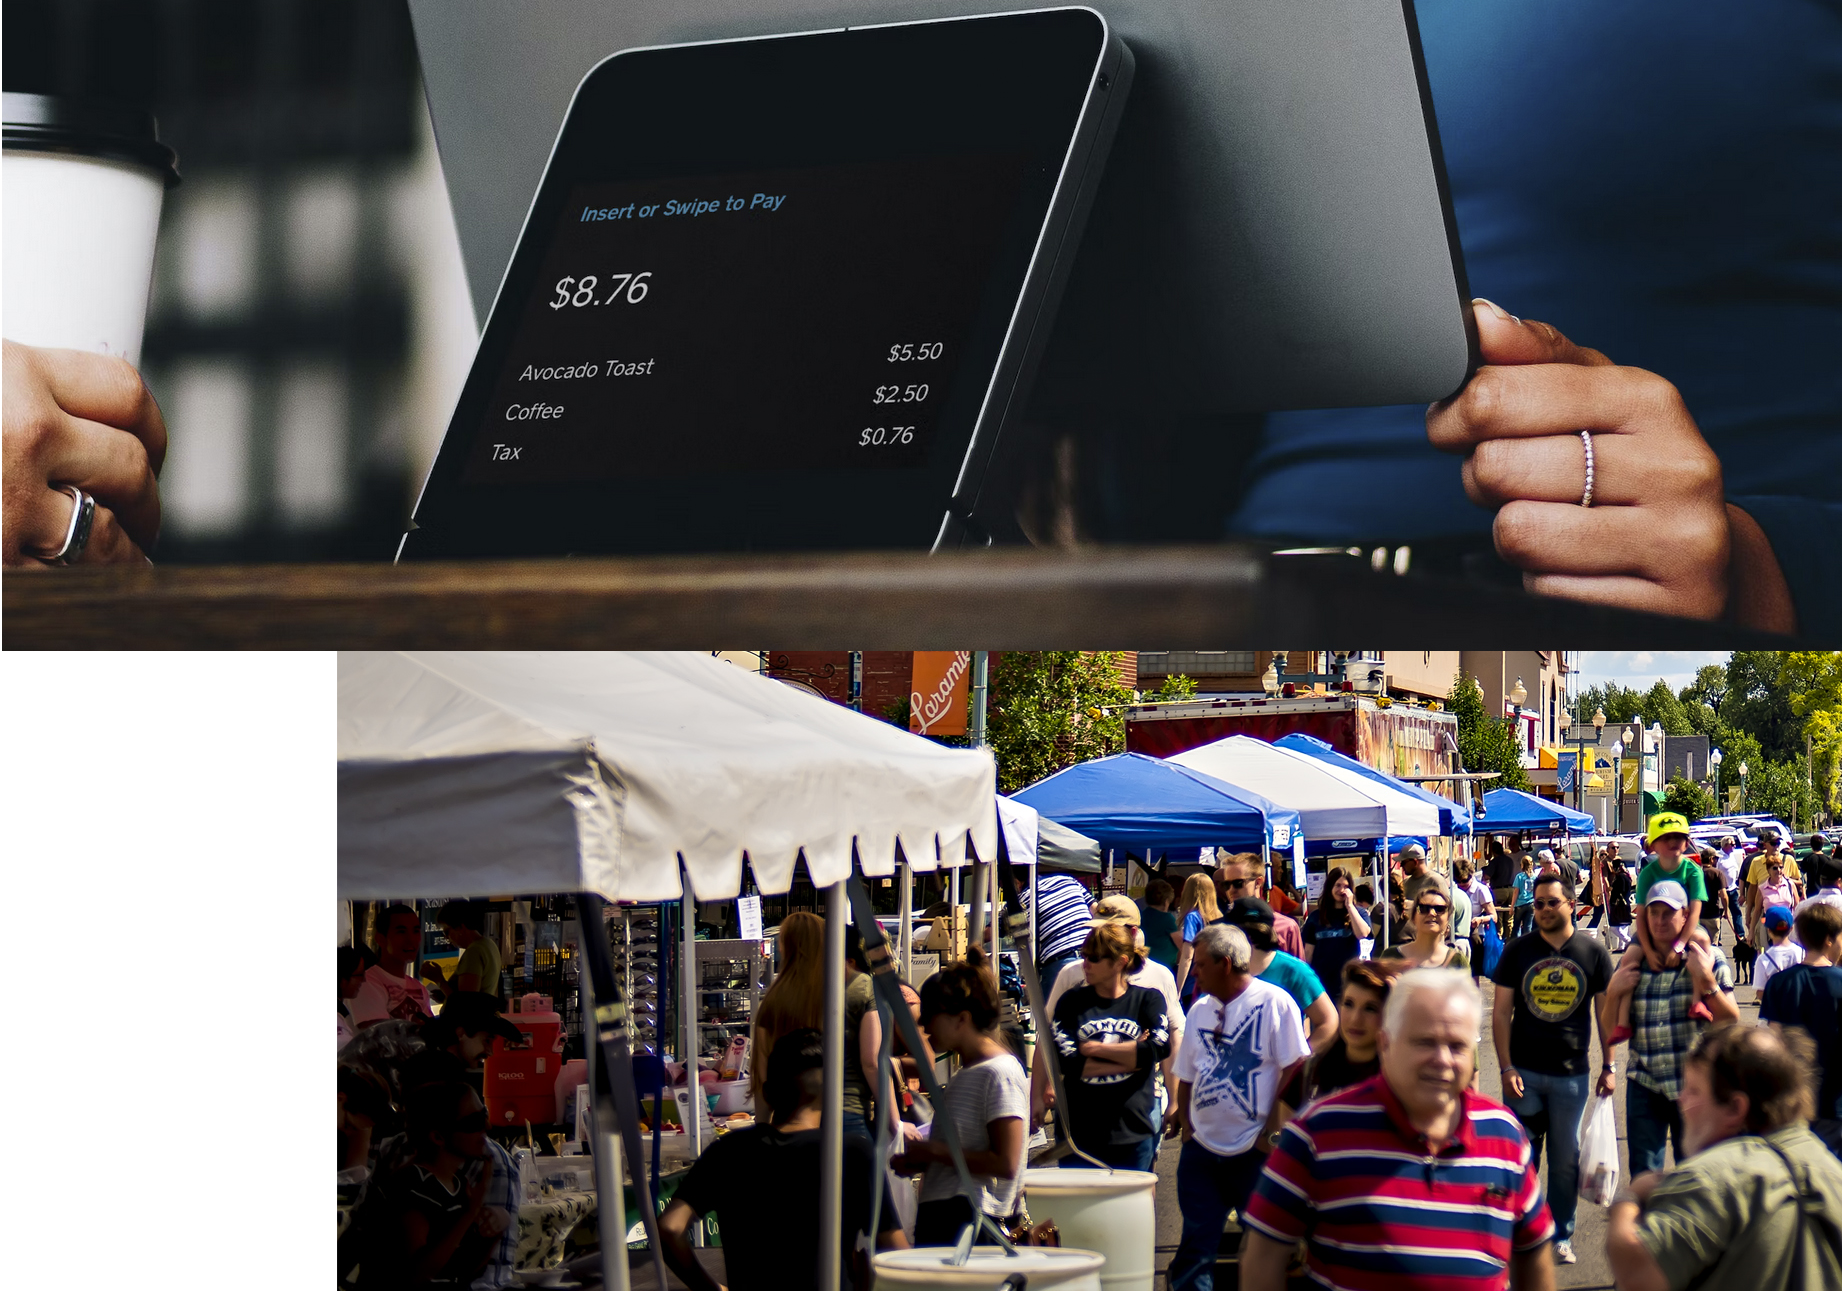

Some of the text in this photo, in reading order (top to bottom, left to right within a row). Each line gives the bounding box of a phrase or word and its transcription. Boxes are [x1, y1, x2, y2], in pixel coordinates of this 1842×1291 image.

[580, 192, 787, 223] Insert or Swipe to Pay
[549, 270, 653, 311] $8.76
[886, 341, 944, 364] $5.50
[519, 358, 656, 382] Avocado Toast
[872, 383, 929, 406] $2.50
[504, 402, 565, 422] Coffee
[858, 426, 915, 448] $0.76
[491, 444, 523, 462] Tax
[910, 650, 971, 735] Laramie
[498, 1072, 525, 1080] IGLOO
